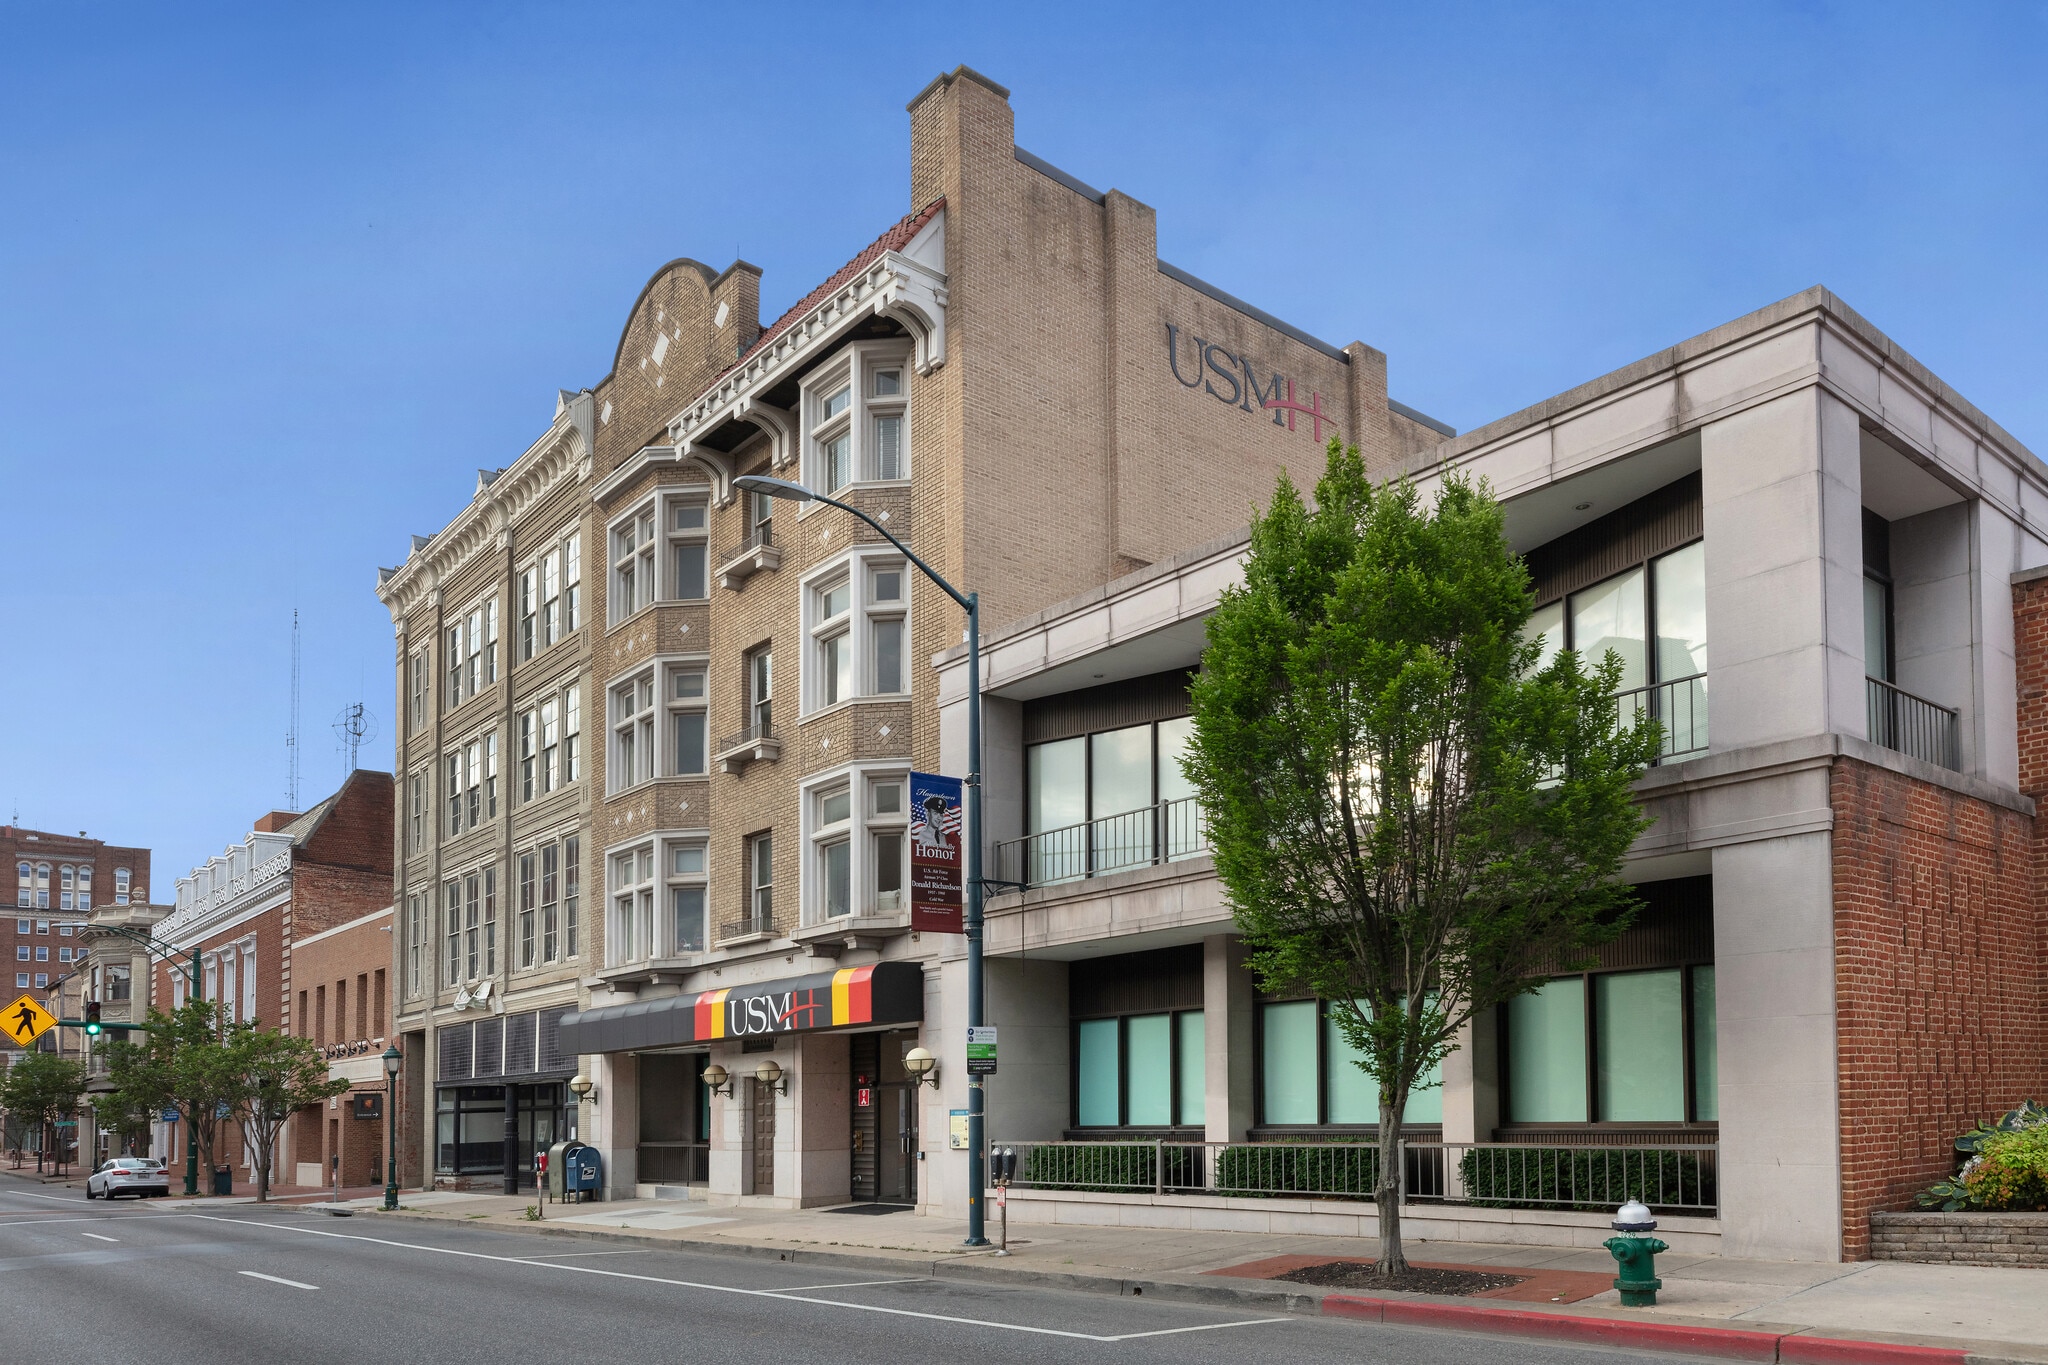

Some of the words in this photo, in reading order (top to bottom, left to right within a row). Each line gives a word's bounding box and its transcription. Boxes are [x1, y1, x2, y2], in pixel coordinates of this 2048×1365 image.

[1165, 322, 1338, 442] USMH
[915, 843, 955, 860] Honor
[911, 880, 931, 888] Donald
[932, 882, 962, 890] Richardson
[730, 987, 824, 1036] USMH
